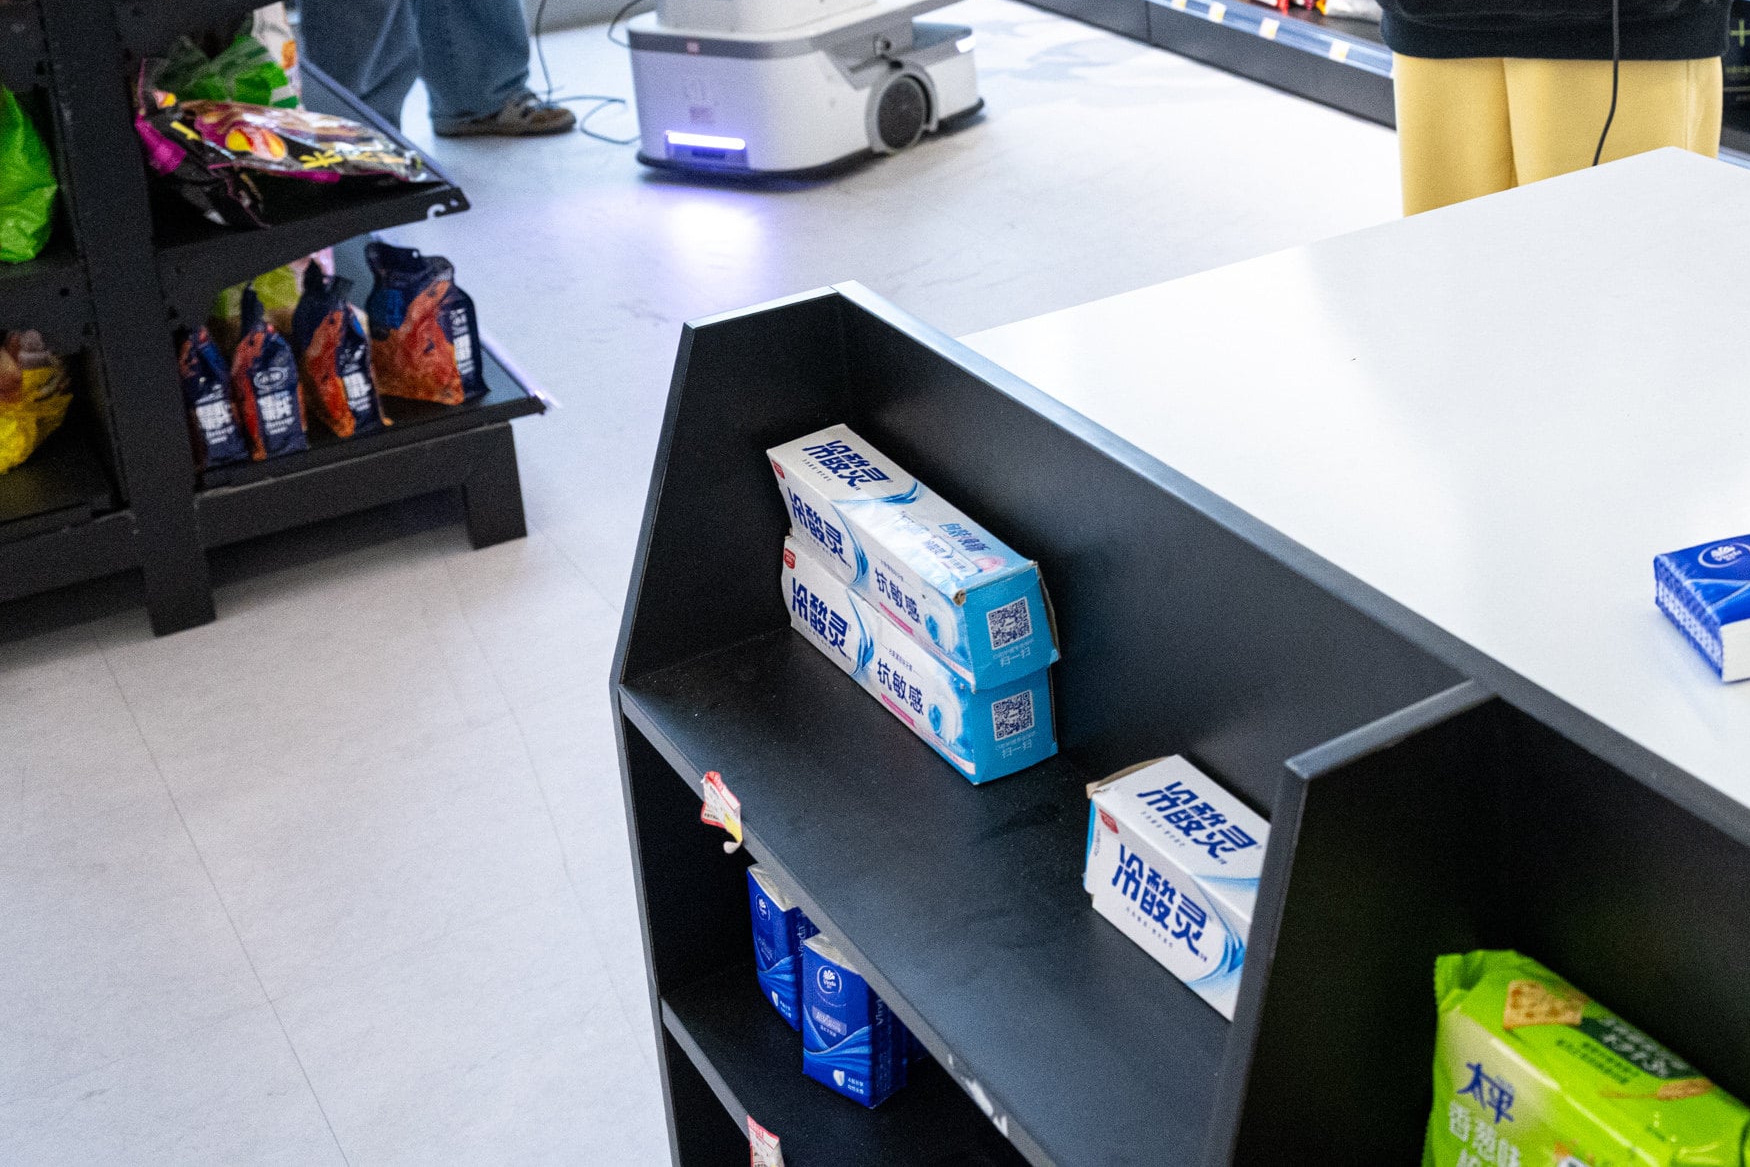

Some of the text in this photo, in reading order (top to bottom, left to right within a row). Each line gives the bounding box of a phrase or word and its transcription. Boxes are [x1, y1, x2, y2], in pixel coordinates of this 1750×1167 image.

[801, 439, 890, 487] 冷酸灵
[787, 486, 852, 569] 冷酸灵
[791, 576, 852, 662] 冷酸灵
[874, 567, 922, 625] 抗敏感
[876, 657, 924, 716] 抗敏感
[1000, 646, 1031, 668] 扫一扫
[1001, 738, 1033, 759] 扫一扫
[1136, 780, 1258, 859] 冷酸灵
[1112, 842, 1208, 957] 冷酸灵
[1456, 1061, 1515, 1125] 太平
